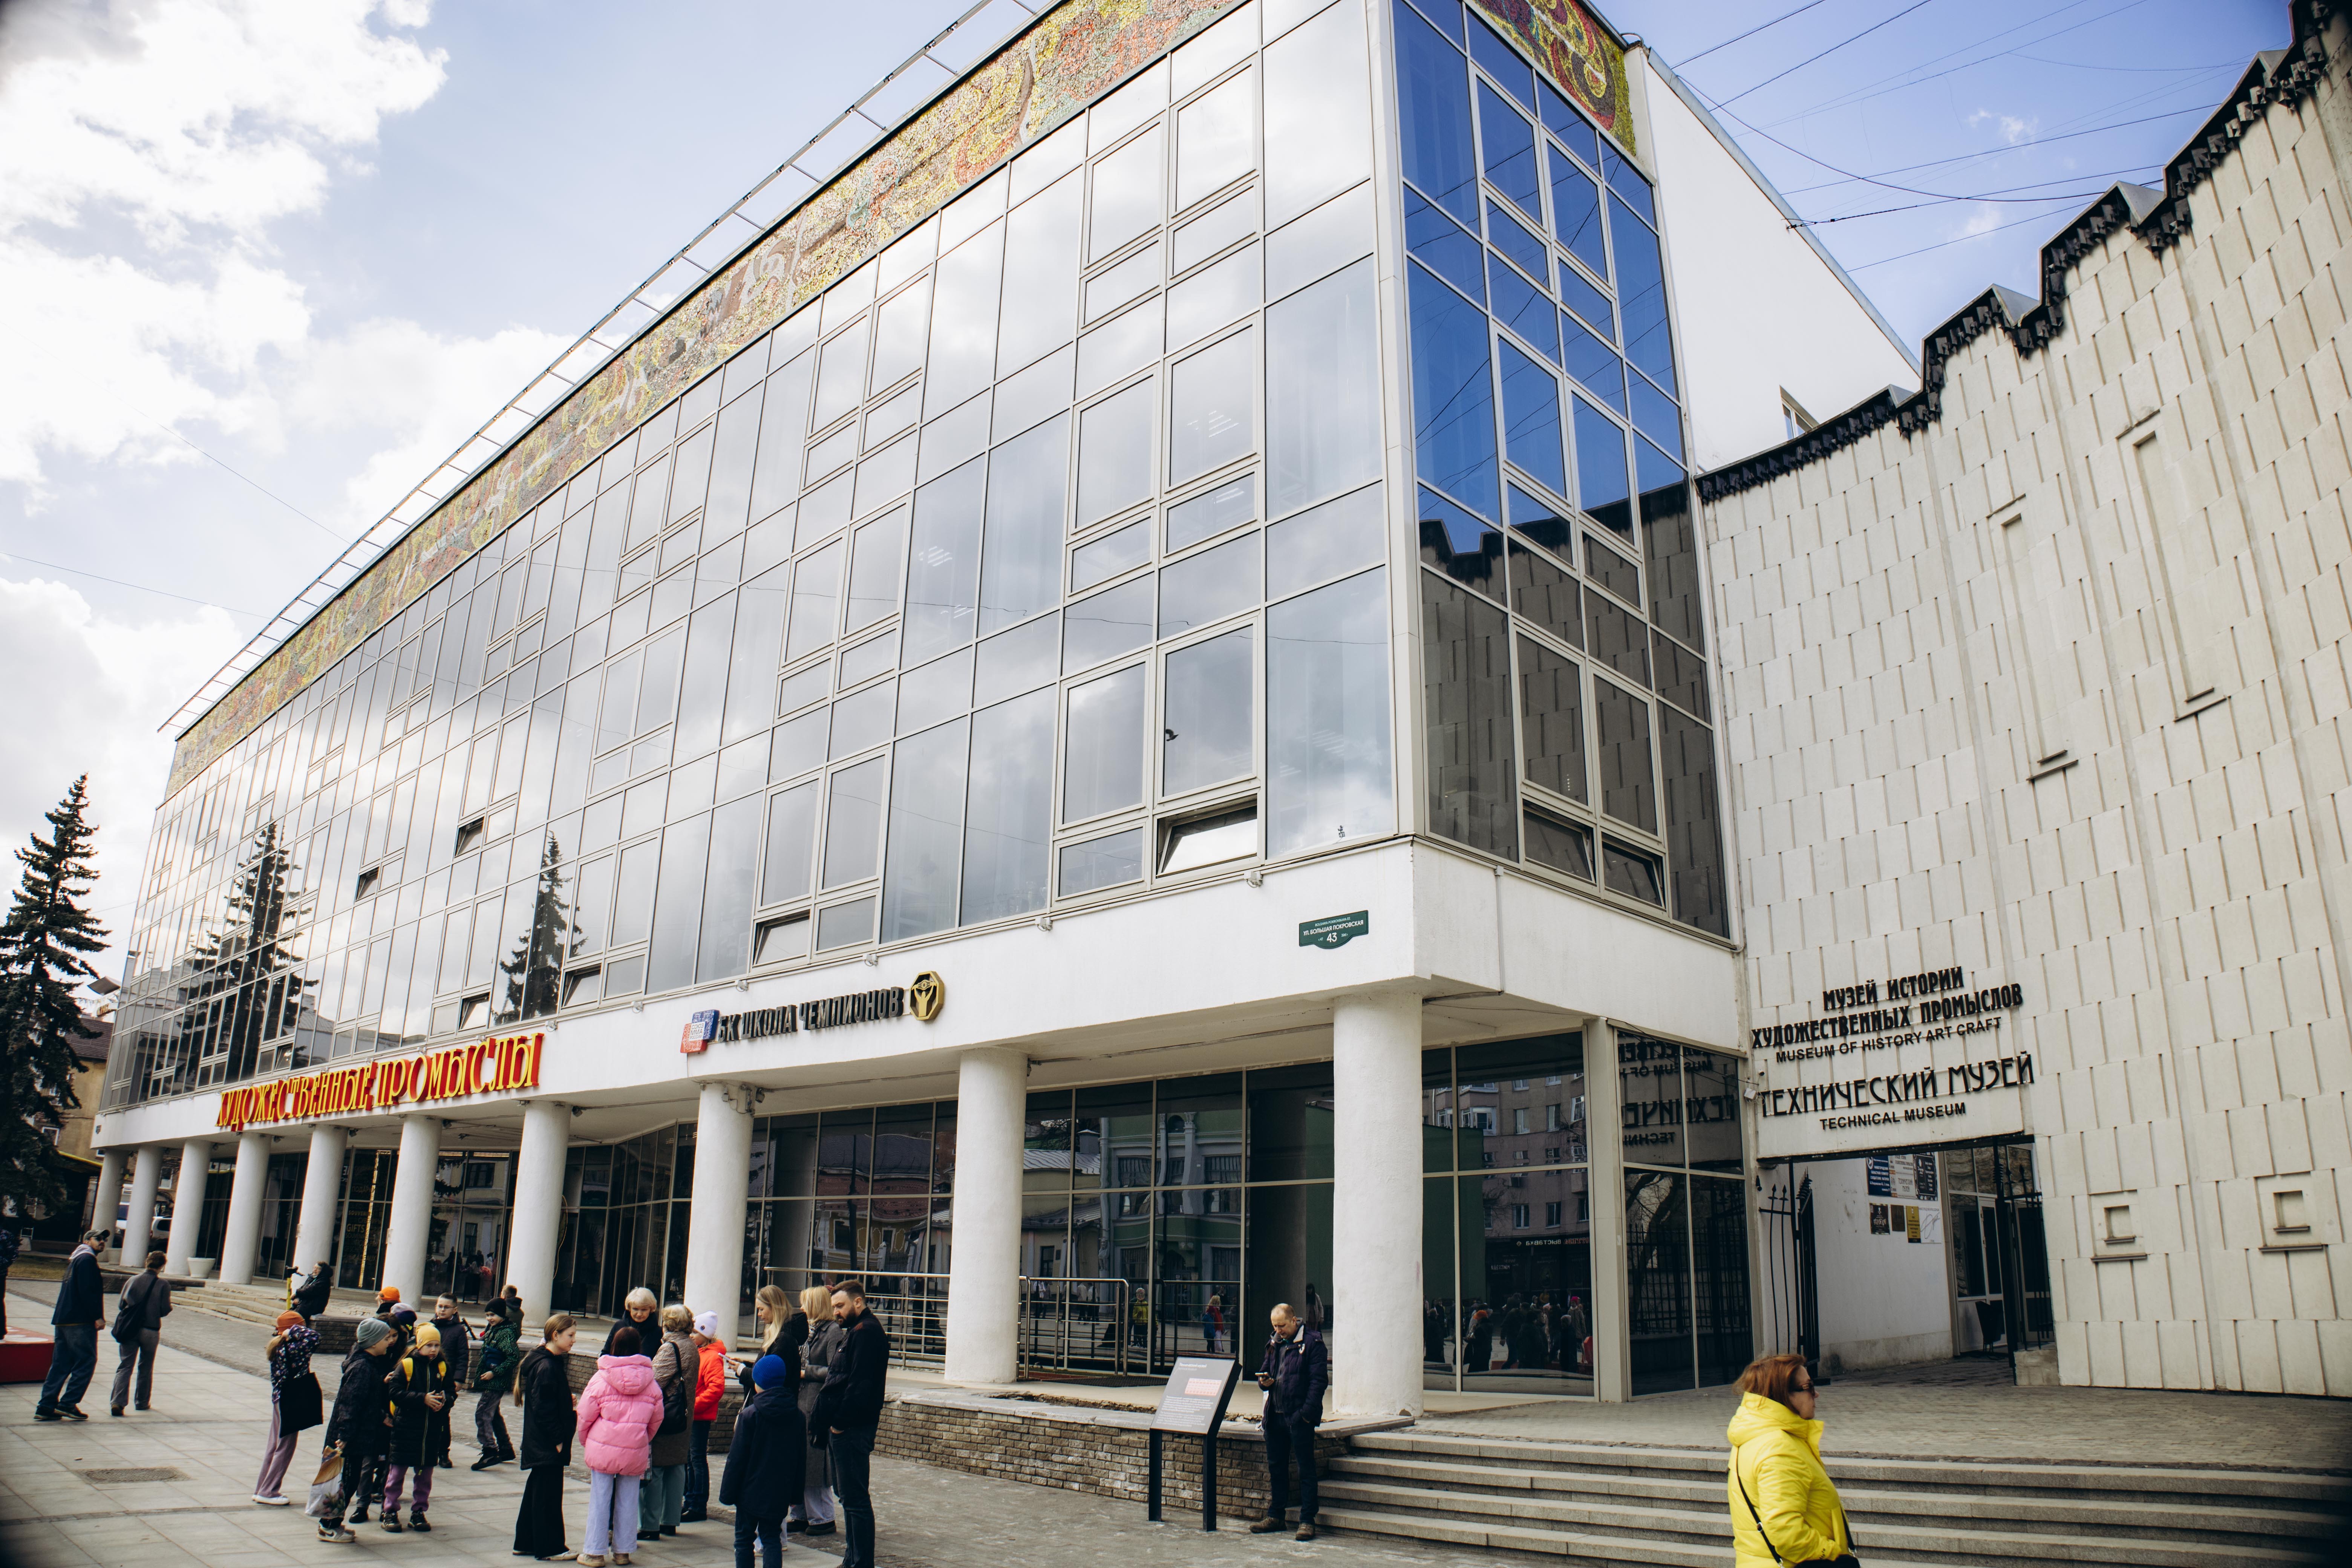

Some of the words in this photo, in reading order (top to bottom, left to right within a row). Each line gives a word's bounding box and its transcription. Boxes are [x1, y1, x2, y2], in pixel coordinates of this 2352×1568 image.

[1310, 926, 1332, 935] БОЛЬШАЯ
[1333, 920, 1364, 930] ПОКРОВСКАЯ
[1326, 932, 1337, 943] 43
[1823, 979, 1878, 1011] МУЗЕЙ
[1887, 966, 1964, 1001] ИСТОРИИ
[741, 1004, 798, 1040] ШКОЛА
[799, 986, 905, 1030] ЧЕМПИОНОВ
[1752, 1005, 1911, 1049] ХУДОЖЕСТВЕННЫХ
[1920, 983, 2023, 1023] ПРОМЫСЛОВ
[1776, 1044, 1835, 1063] MUSEUM
[1839, 1041, 1857, 1054] OF
[1862, 1031, 1922, 1052] HISTORY
[1925, 1026, 1952, 1041] ART
[1957, 1017, 2002, 1036] CRAFT
[215, 1061, 378, 1132] ХУДОЖЕСТВЕННЫЕ
[375, 1033, 545, 1106] ПРОМЫСЛЫ
[1761, 1066, 1937, 1118] ТЕХНИЧЕСКИЙ
[1948, 1051, 2034, 1095] МУЗЕЙ
[1820, 1112, 1900, 1130] TECHNICAL
[1905, 1102, 1966, 1122] MUSEUM
[346, 1223, 365, 1233] GIFTS
